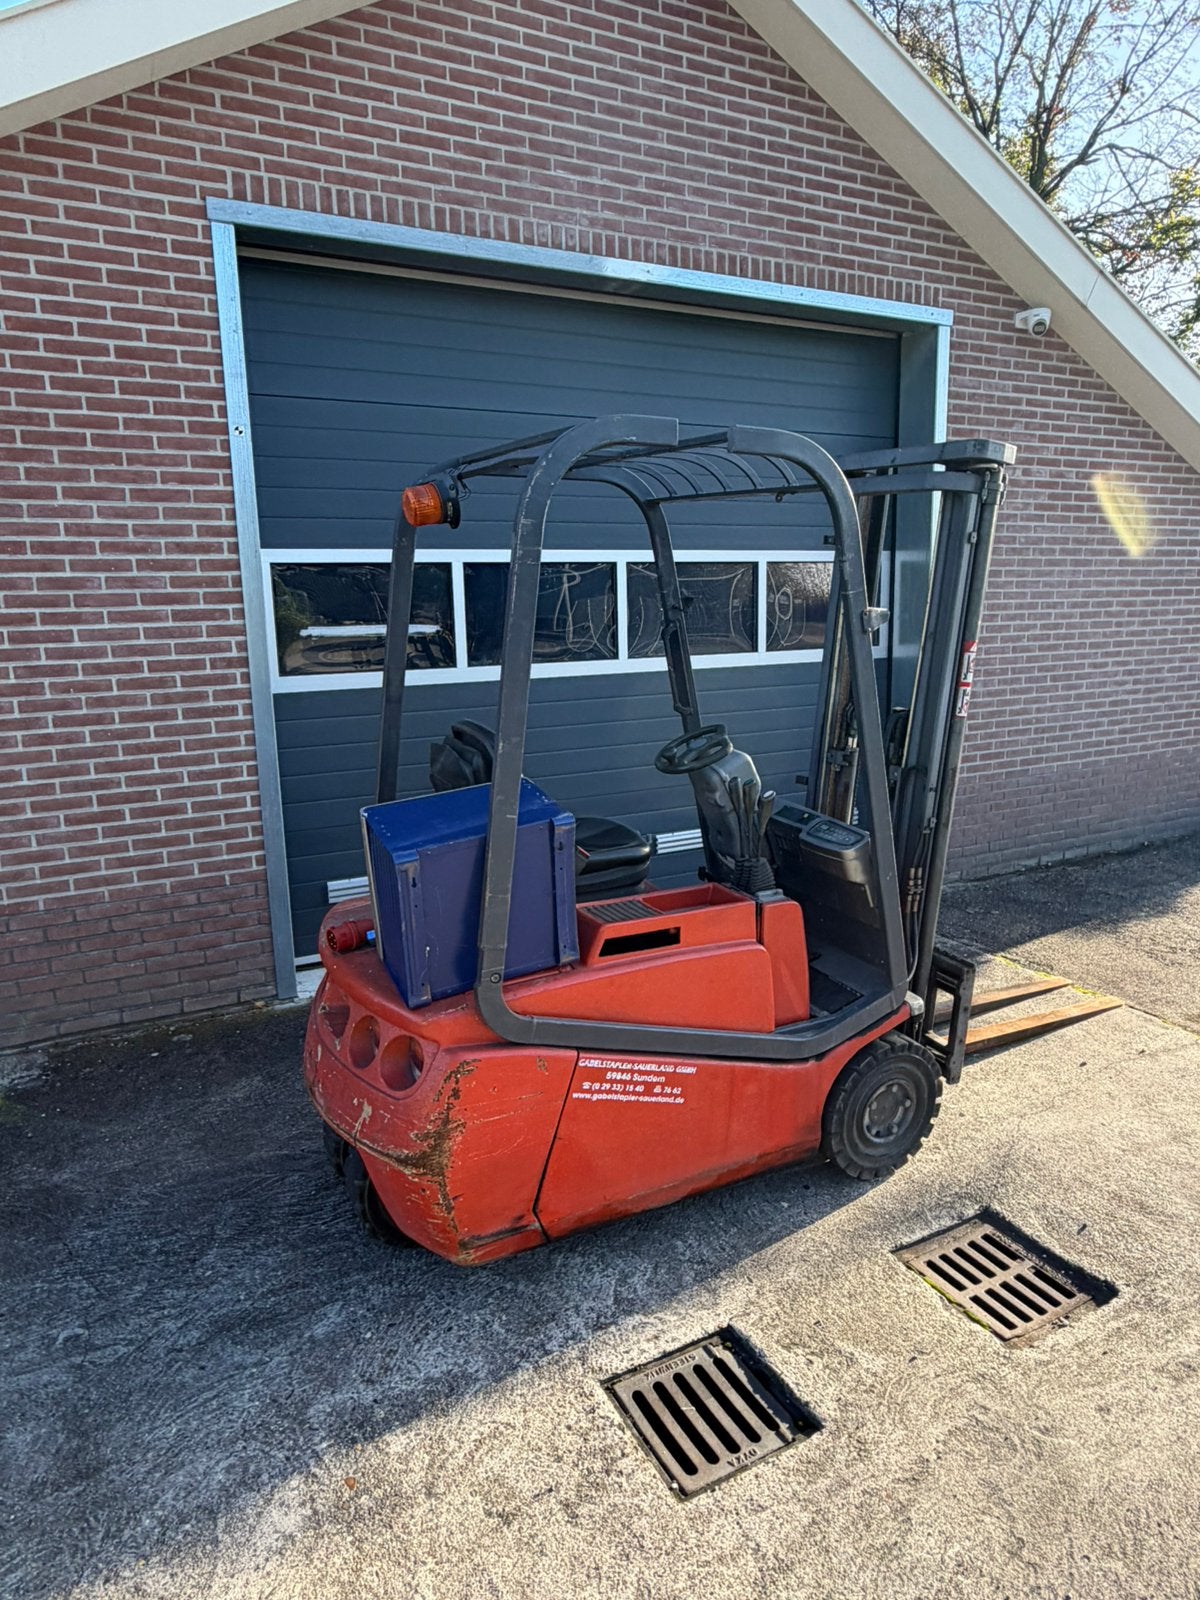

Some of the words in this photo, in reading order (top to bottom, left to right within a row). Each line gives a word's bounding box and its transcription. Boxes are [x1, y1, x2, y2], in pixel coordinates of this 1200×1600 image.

[605, 1071, 631, 1080] 59846
[632, 1073, 666, 1083] Sundern
[635, 1084, 645, 1092] 40
